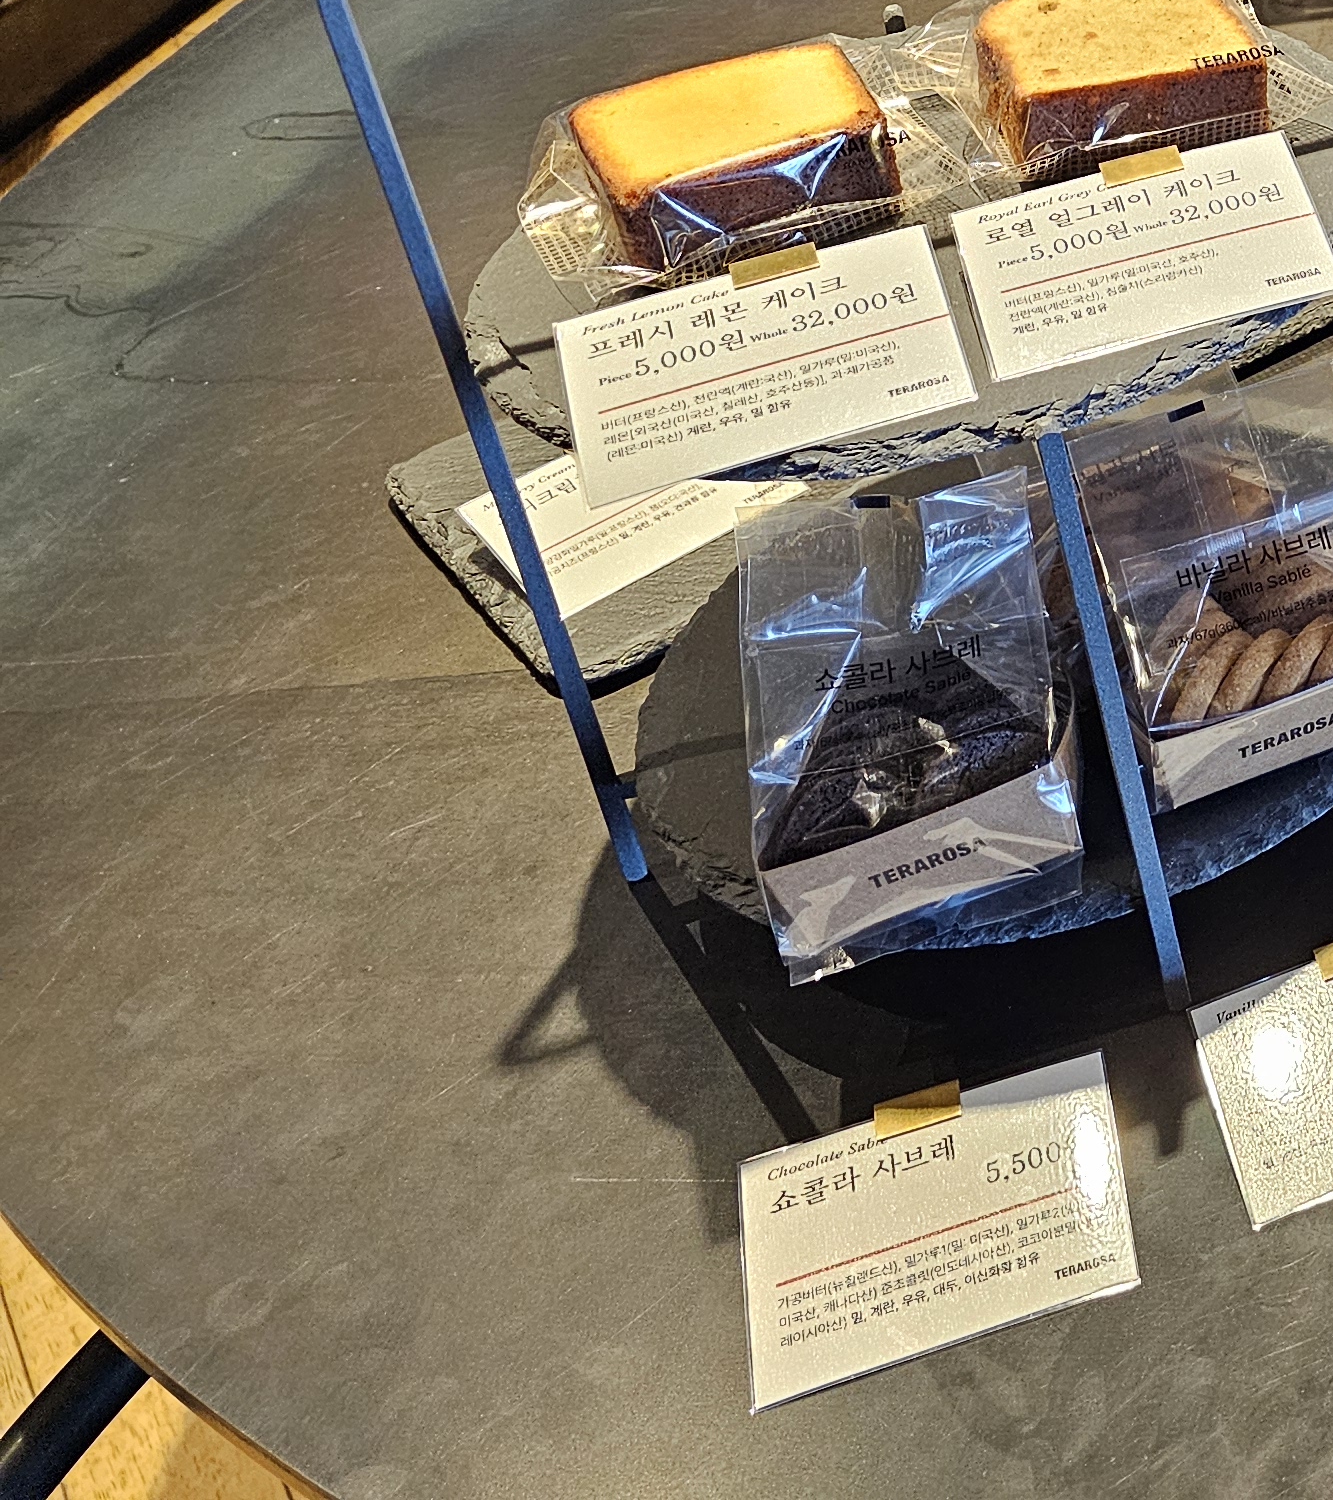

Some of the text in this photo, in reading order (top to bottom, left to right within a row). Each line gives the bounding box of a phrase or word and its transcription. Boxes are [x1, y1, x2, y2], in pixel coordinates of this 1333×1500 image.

[1190, 43, 1285, 70] TERAROSA
[977, 186, 1094, 225] Royal Earl Grey
[984, 168, 1241, 246] 로열 얼그레이 케이크
[997, 183, 1285, 269] Piece 5,000원 Whole 32,000원
[1265, 267, 1322, 288] TERAROSA
[581, 288, 730, 336] Fresh Lemon Cake
[587, 275, 848, 360] 프레시 레몬 케이크
[598, 282, 919, 387] Piece 5,000원 Whole 32,000원
[887, 374, 950, 398] TERAROSA
[538, 462, 576, 485] Cream
[1175, 525, 1333, 590] 바닐라 사브레
[1212, 564, 1312, 603] Vanilla Sablé
[814, 634, 982, 692] 쇼콜라 사브레
[832, 685, 920, 714] Chocolate
[867, 835, 988, 890] TERAROSA
[767, 1149, 844, 1182] Chocolate
[769, 1134, 957, 1215] 쇼콜라 사브레
[985, 1140, 1062, 1184] 5,500
[1054, 1252, 1117, 1281] TERAROSA
